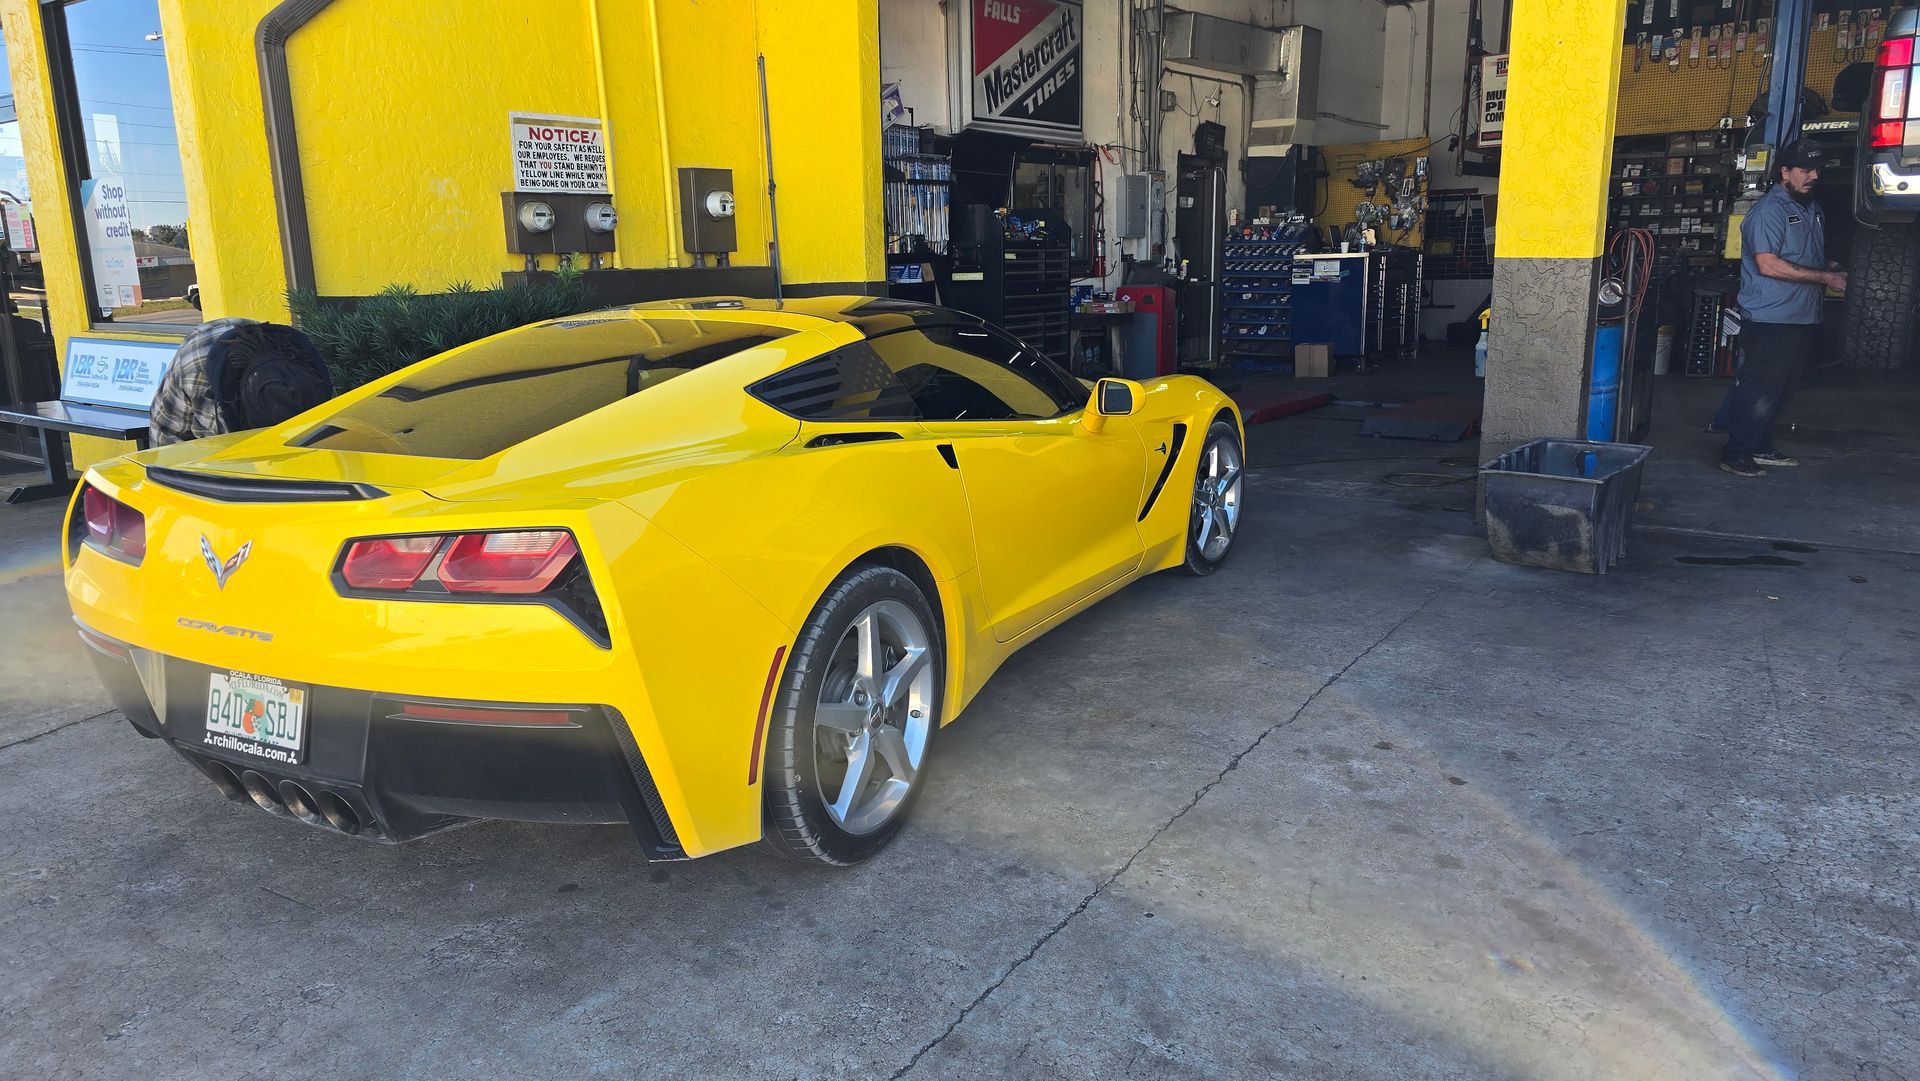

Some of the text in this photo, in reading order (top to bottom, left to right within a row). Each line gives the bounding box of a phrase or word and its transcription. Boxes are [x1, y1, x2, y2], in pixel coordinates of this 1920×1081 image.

[984, 0, 1020, 25] FALLS
[983, 8, 1076, 117] Mastercraft
[1023, 58, 1076, 115] TIRES
[1486, 101, 1505, 112] PI
[529, 127, 597, 145] NOTICE!
[519, 141, 533, 150] FOR
[535, 142, 552, 151] YOUR
[553, 143, 578, 153] SAFETY
[578, 145, 586, 153] AS
[517, 151, 531, 160] OUR
[573, 154, 583, 162] WE
[519, 160, 537, 169] THAT
[539, 161, 552, 170] YOU
[554, 162, 575, 170] STAND
[576, 163, 598, 171] BEHIND
[520, 170, 548, 178] YELLOW
[549, 171, 564, 179] LINE
[586, 172, 604, 180] WORK
[520, 179, 541, 187] BEING
[542, 180, 559, 188] DONE
[560, 180, 569, 188] ON
[587, 181, 600, 189] CAR
[102, 184, 124, 202] Shop
[95, 204, 128, 220] without
[106, 222, 130, 239] credit
[176, 617, 273, 642] CORVETTE
[254, 674, 282, 687] FLORIDA
[209, 689, 299, 741] 84D SBJ
[213, 735, 287, 762] rchillocala.com
